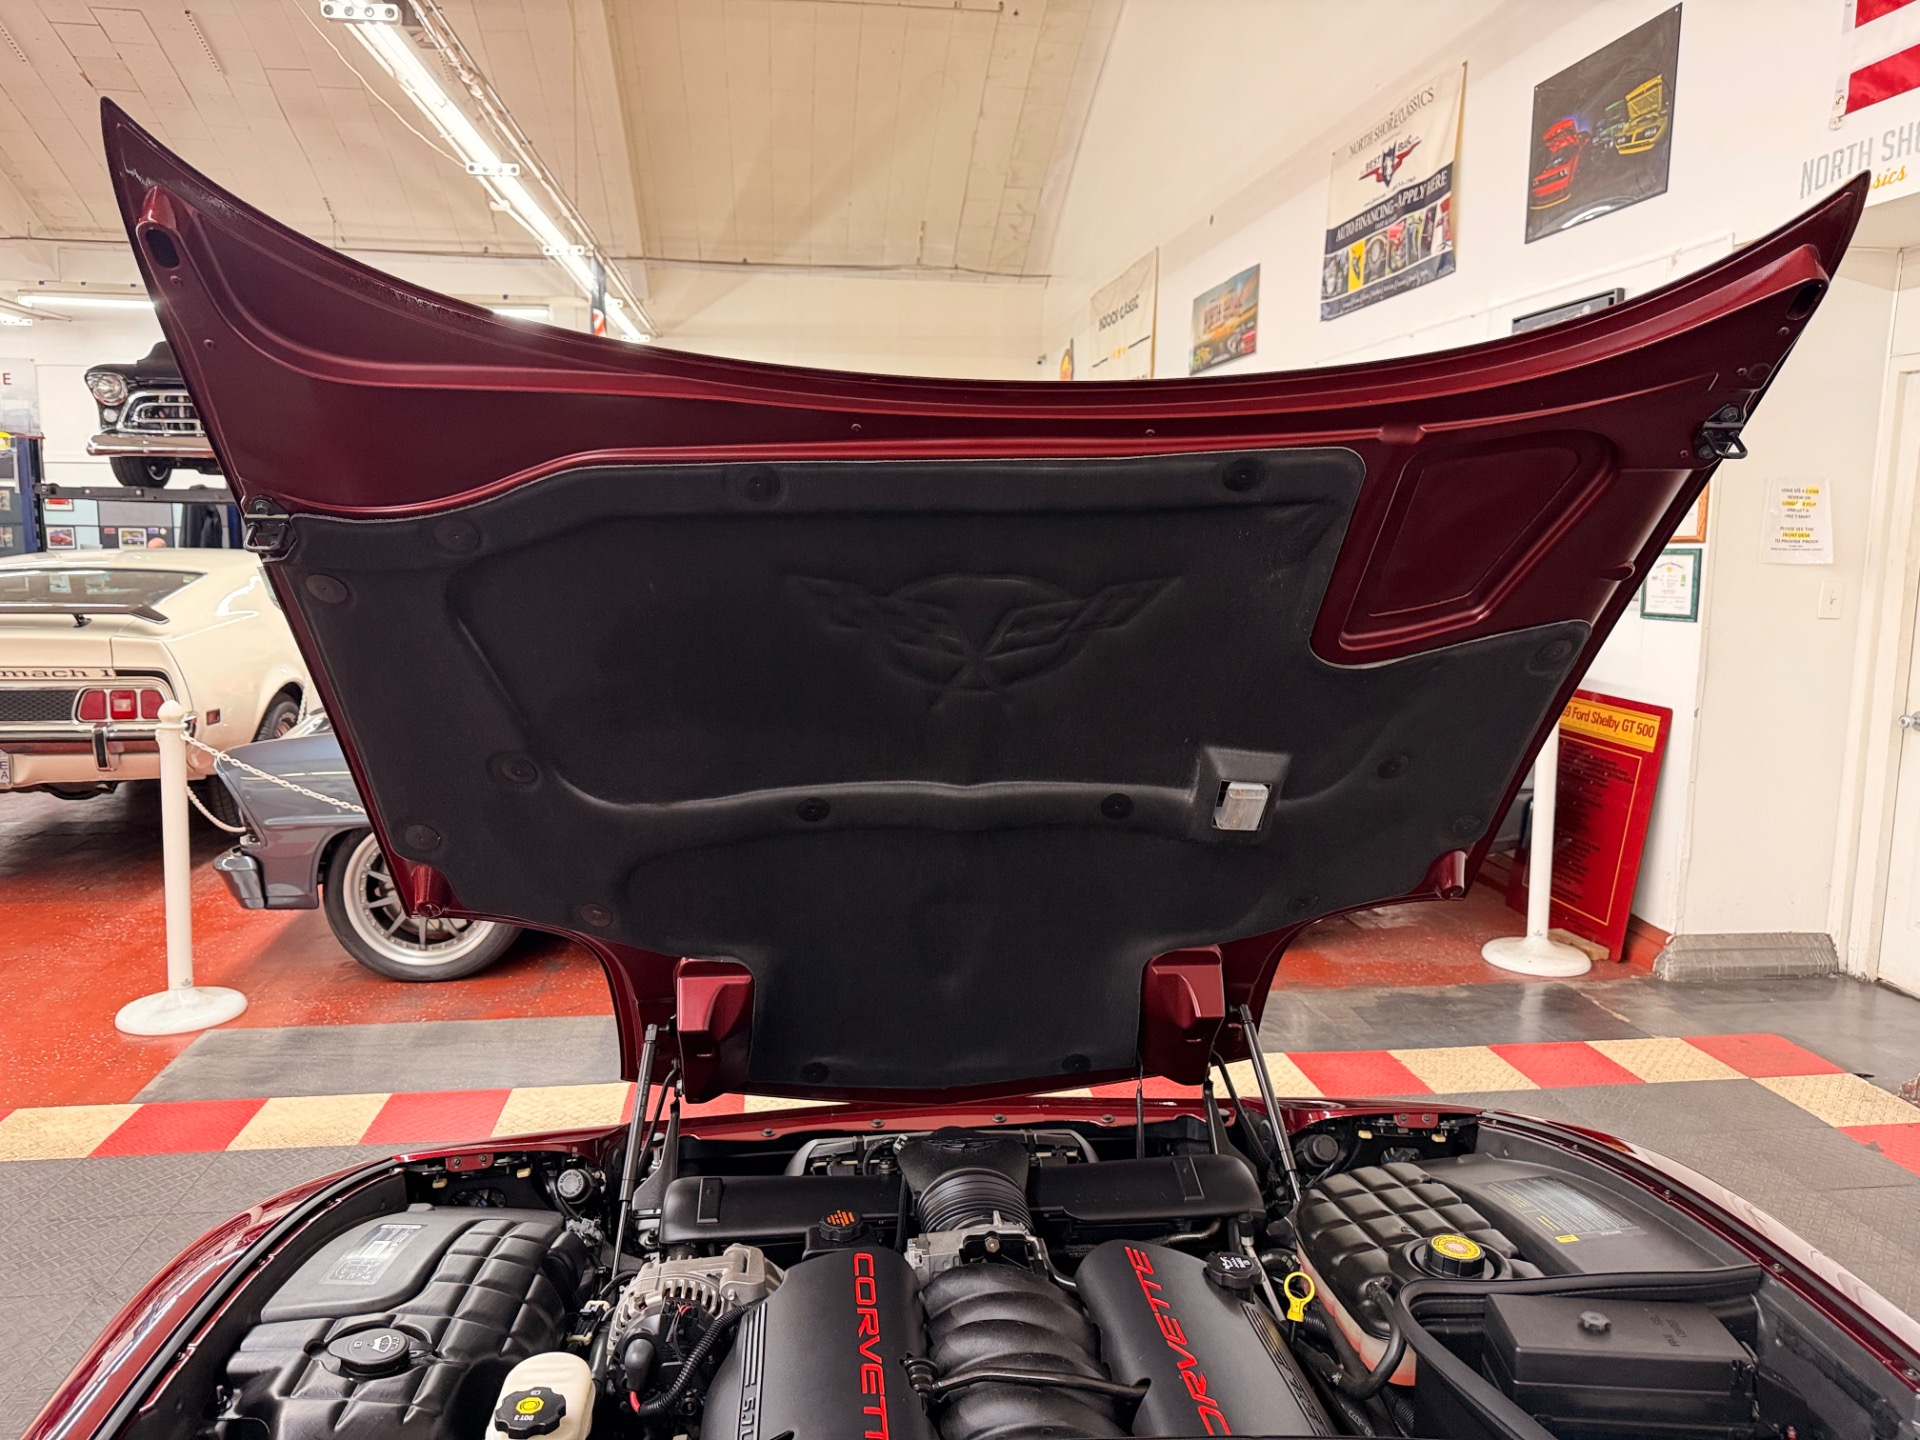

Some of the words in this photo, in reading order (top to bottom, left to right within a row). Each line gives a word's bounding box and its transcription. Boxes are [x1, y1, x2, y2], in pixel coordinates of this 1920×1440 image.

[1800, 138, 1874, 199] NORTH
[1870, 165, 1908, 190] sics
[1425, 169, 1448, 196] HERE
[0, 668, 88, 679] mach
[100, 668, 114, 679] 1
[1573, 708, 1591, 724] Ford
[1590, 711, 1621, 732] Shelby
[1621, 720, 1637, 734] GT
[1636, 722, 1656, 738] 500
